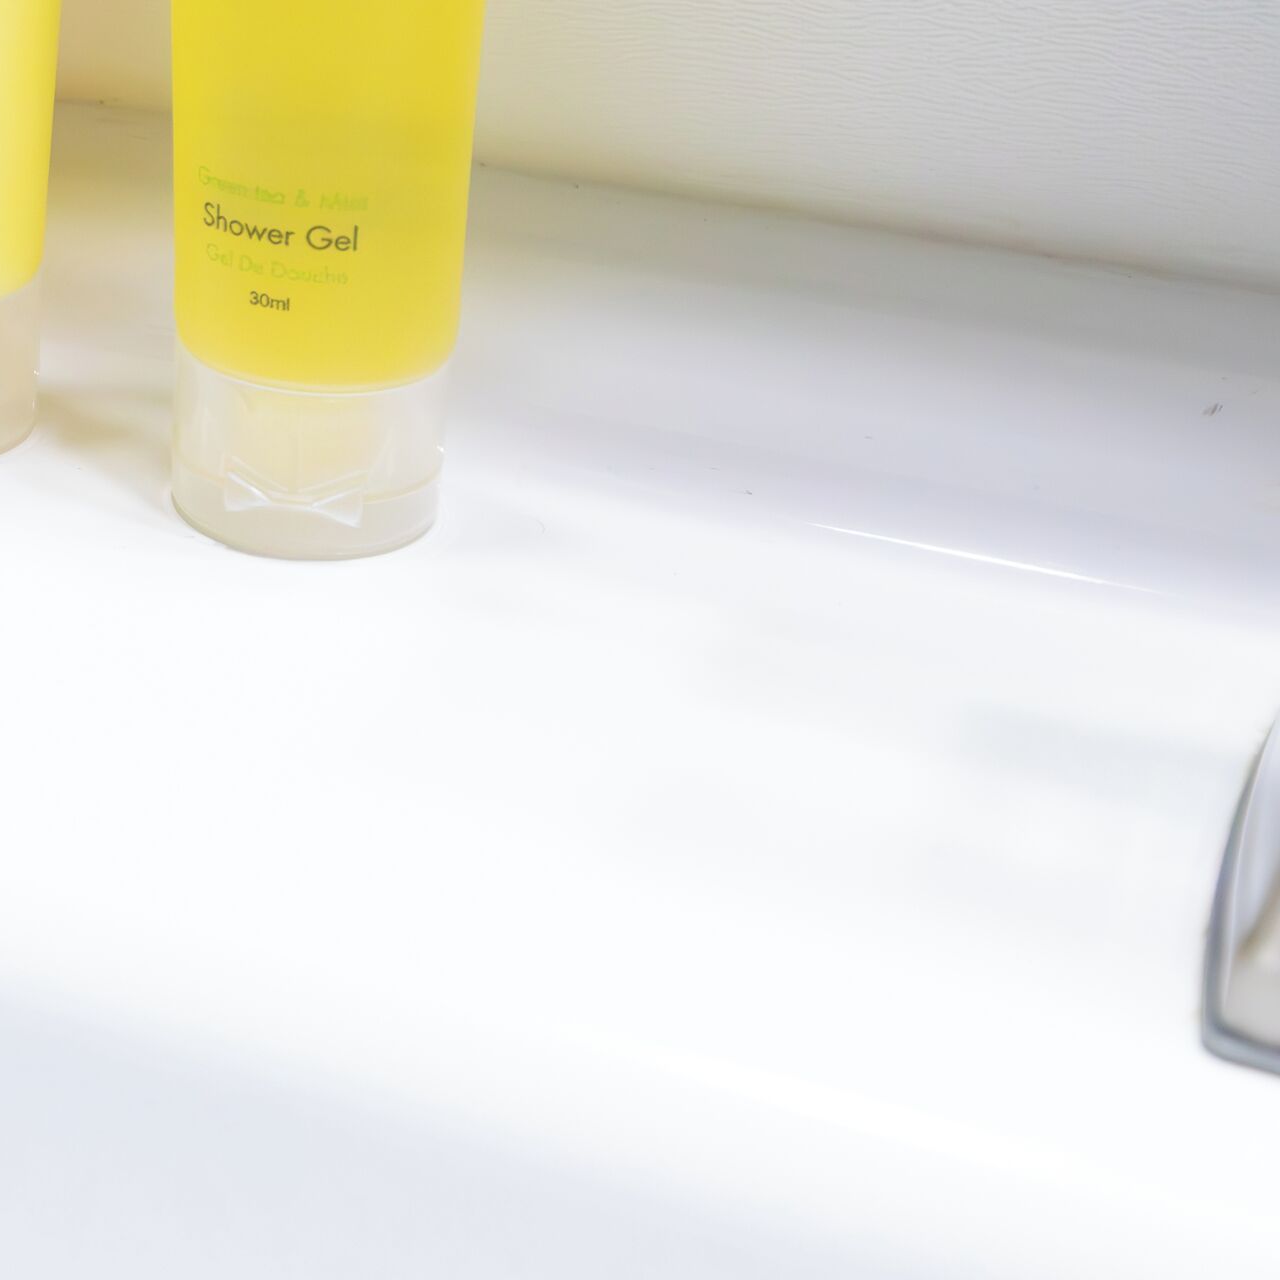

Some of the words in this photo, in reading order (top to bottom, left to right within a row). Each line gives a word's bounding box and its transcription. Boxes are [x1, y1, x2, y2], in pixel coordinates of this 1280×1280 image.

[203, 201, 295, 246] Shower
[306, 225, 359, 252] Gel
[249, 290, 290, 311] 30ml
